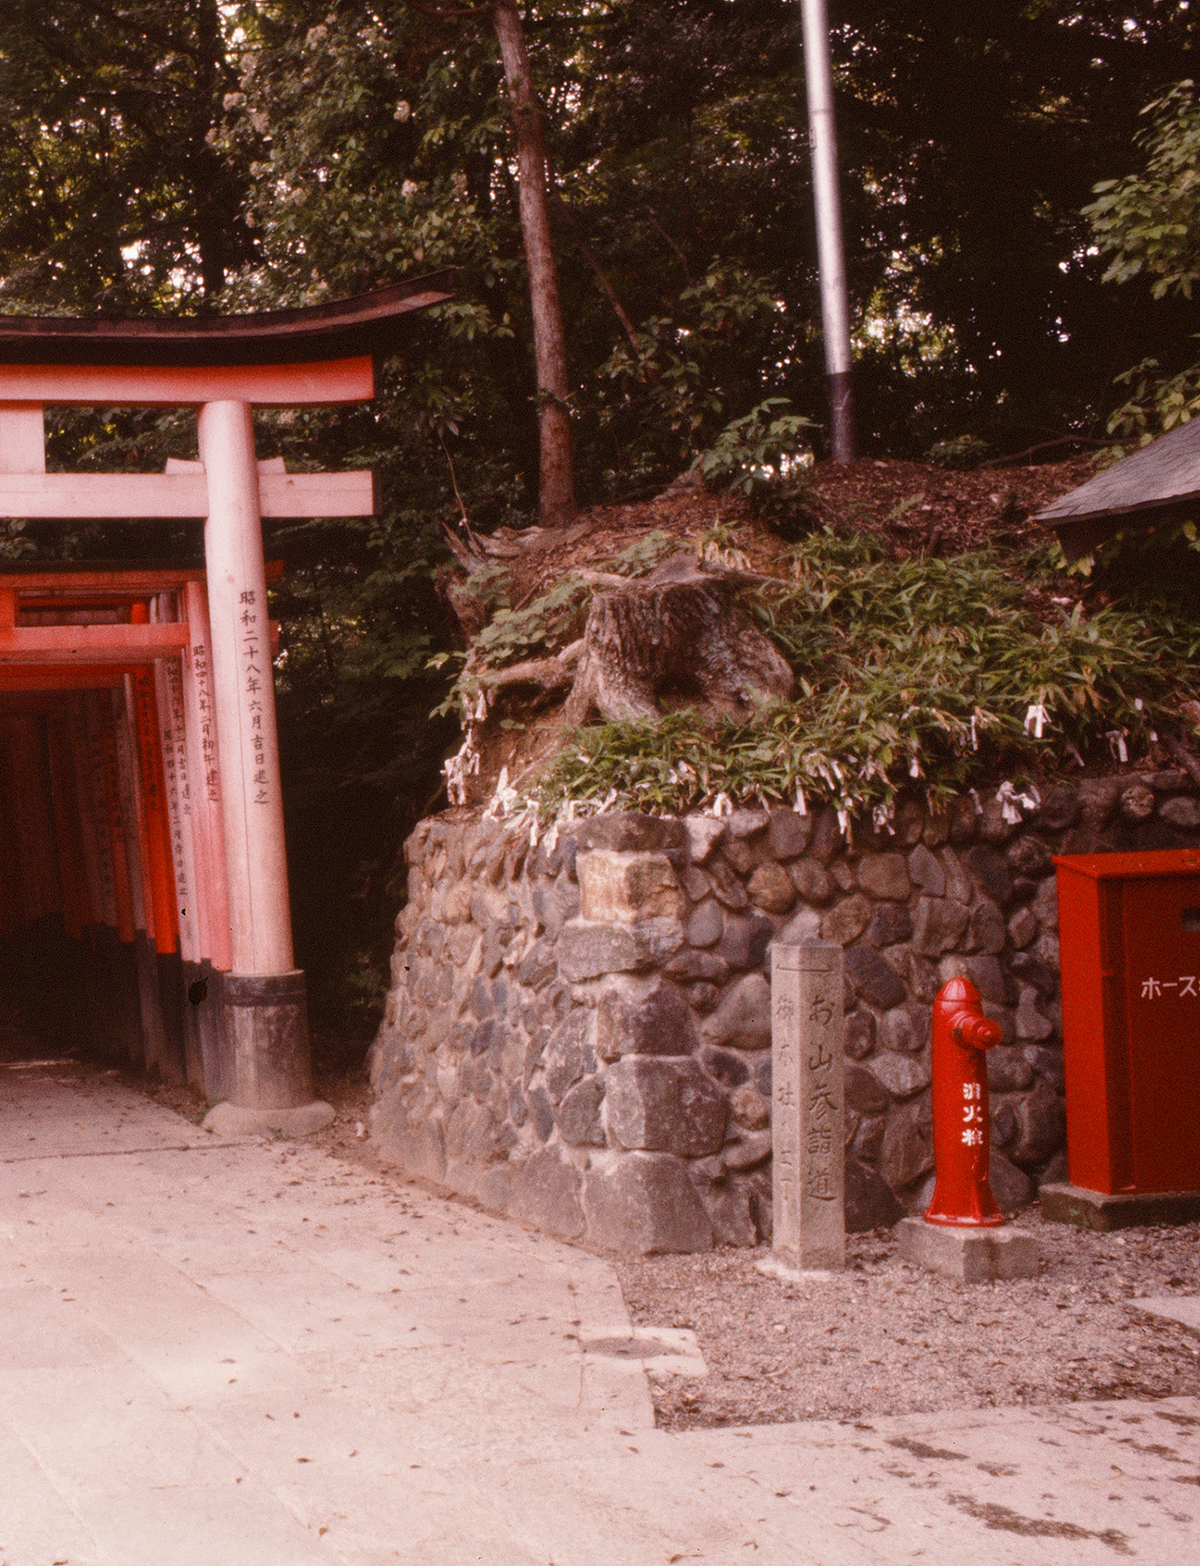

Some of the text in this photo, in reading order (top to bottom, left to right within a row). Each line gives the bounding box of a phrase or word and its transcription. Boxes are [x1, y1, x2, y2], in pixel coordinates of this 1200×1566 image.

[238, 590, 269, 805] 昭和二十八年六月吉日建之
[1141, 975, 1200, 1001] ホース
[807, 994, 838, 1202] お山参詣道
[961, 1082, 984, 1147] 消火栓
